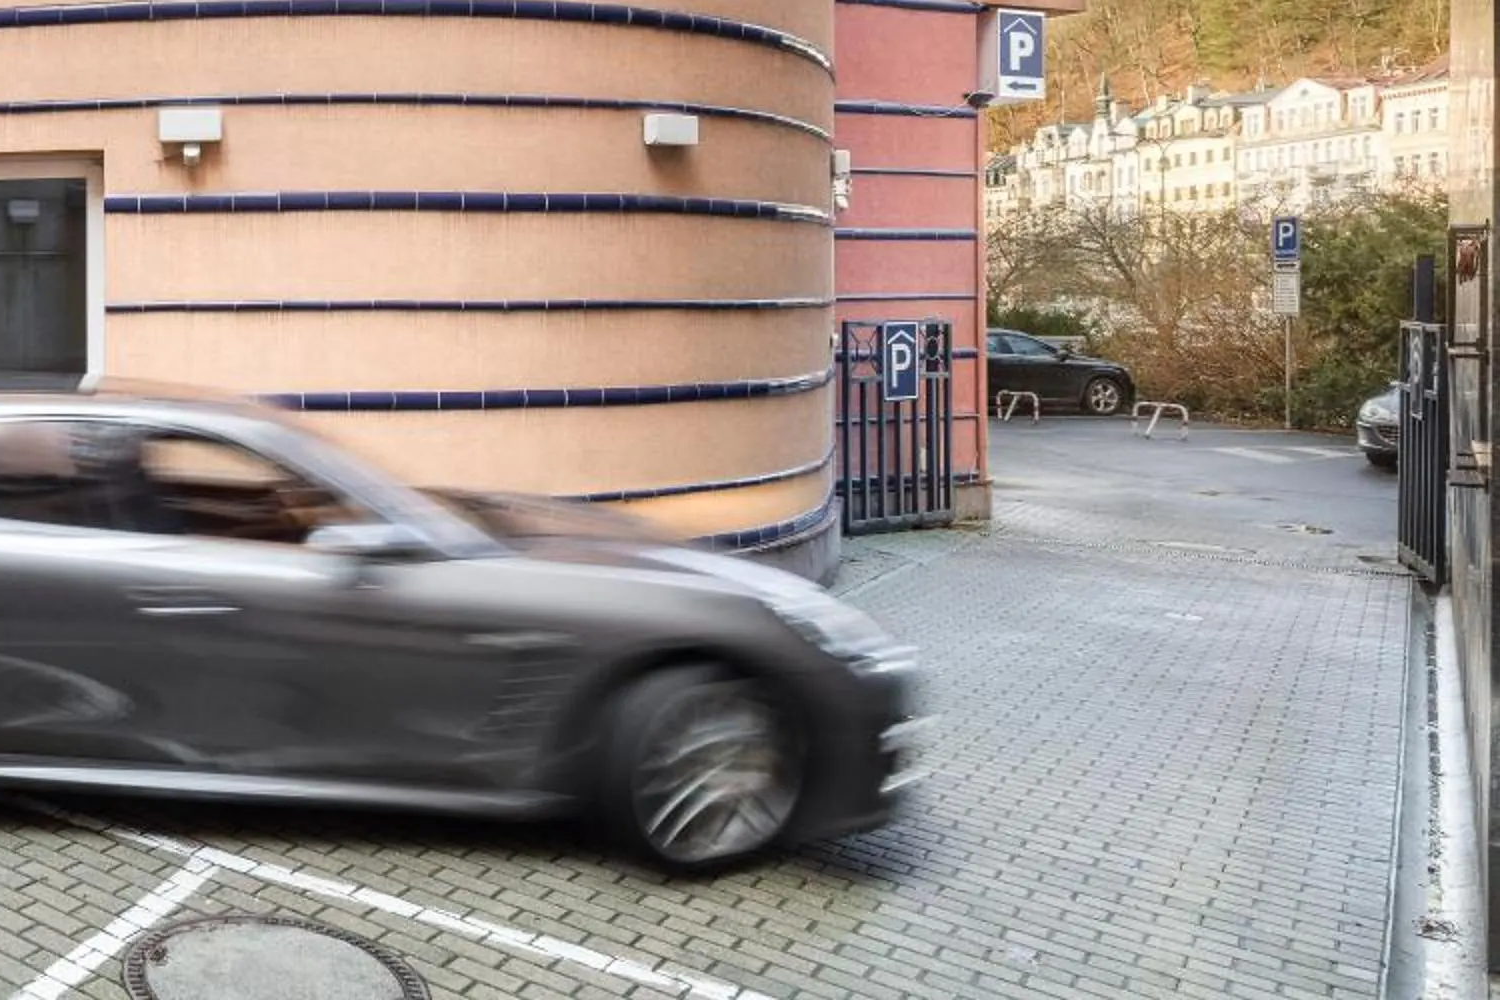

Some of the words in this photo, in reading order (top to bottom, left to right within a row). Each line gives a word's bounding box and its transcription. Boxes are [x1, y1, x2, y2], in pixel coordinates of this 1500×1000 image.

[1009, 31, 1034, 71] P
[1278, 223, 1295, 248] P
[891, 343, 911, 388] P
